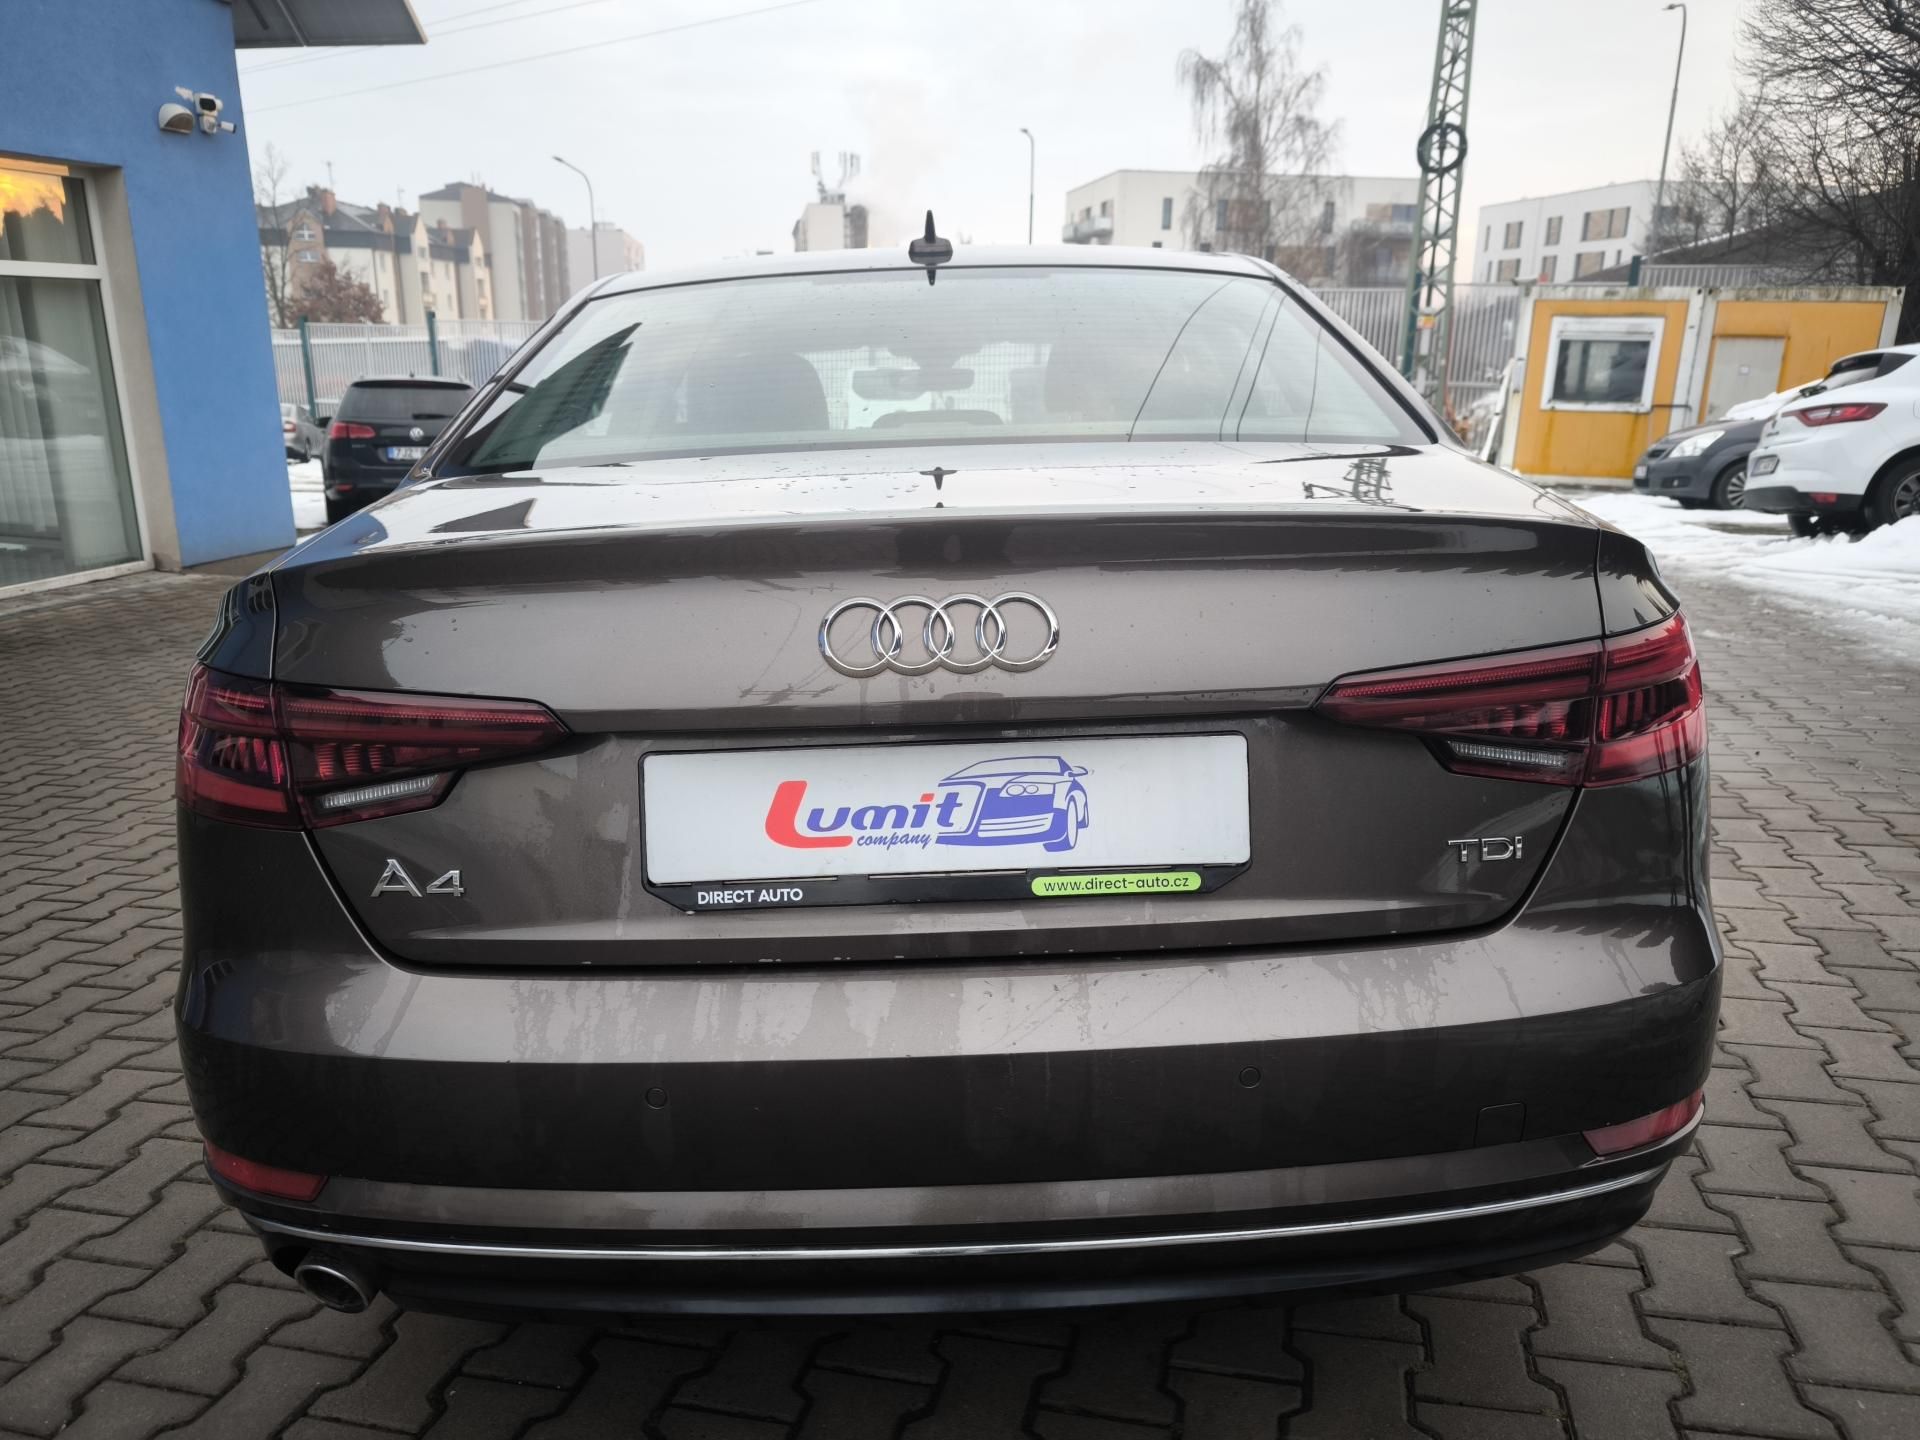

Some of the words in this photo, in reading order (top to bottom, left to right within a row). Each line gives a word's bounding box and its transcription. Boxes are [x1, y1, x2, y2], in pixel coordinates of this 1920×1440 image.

[764, 780, 963, 848] Lumit
[856, 831, 932, 850] company
[1447, 836, 1523, 862] TDI
[369, 858, 465, 898] A4
[1043, 876, 1190, 892] www.direct-auto.cz
[697, 889, 755, 905] DIRECT
[758, 887, 803, 903] AUTO
